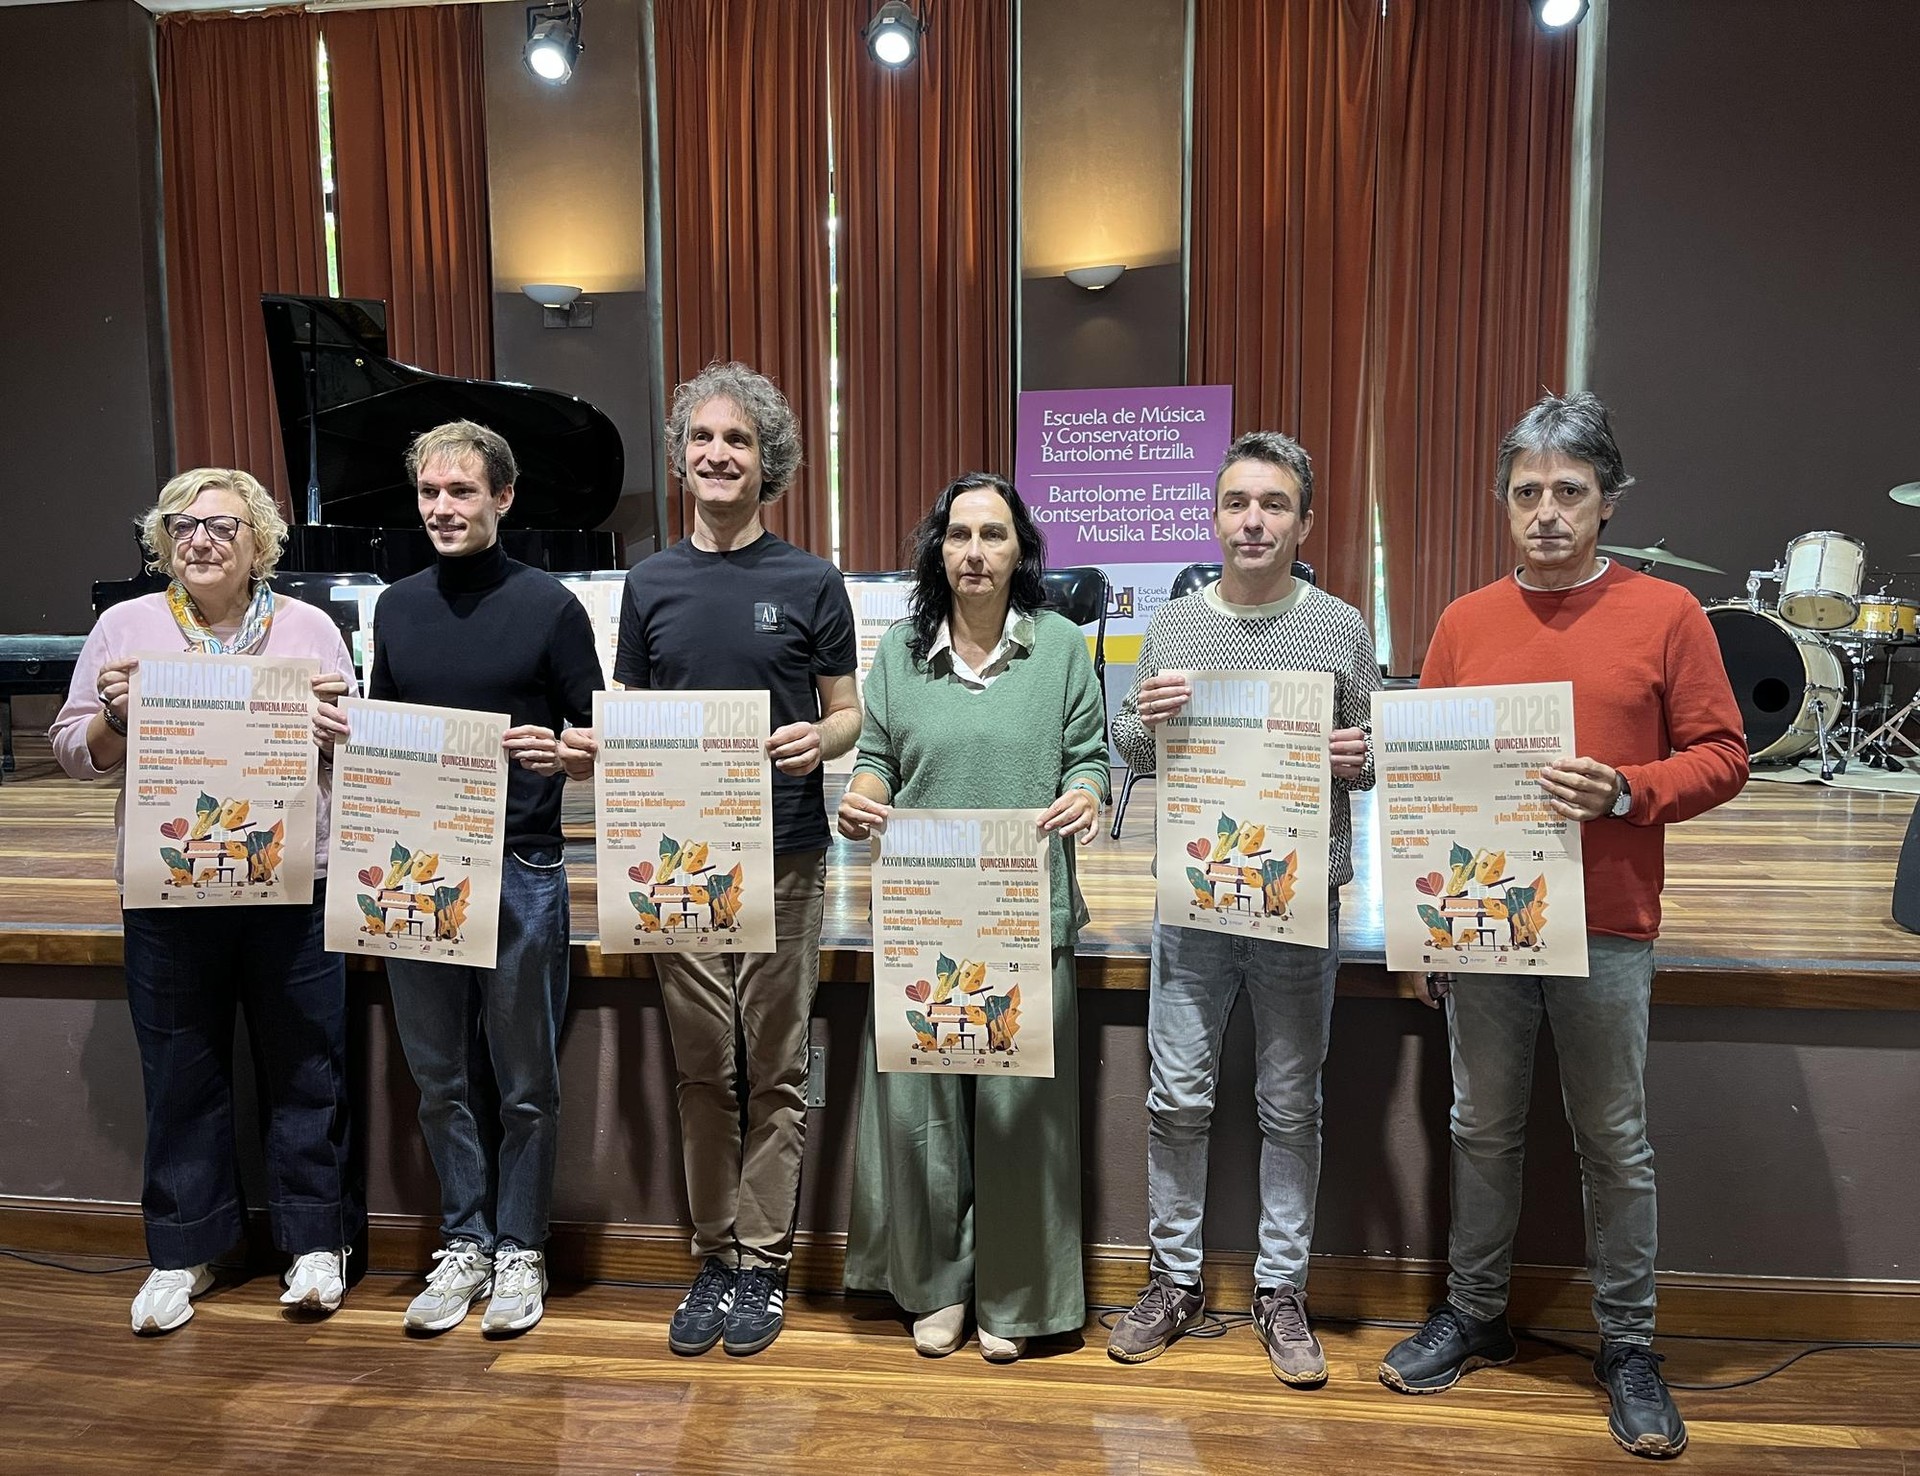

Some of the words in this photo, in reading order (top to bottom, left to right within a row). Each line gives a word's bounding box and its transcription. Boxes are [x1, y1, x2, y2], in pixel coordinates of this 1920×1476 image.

[1043, 409, 1107, 426] Escuela
[1113, 408, 1135, 425] de
[1140, 406, 1205, 423] Música
[1041, 429, 1053, 447] y
[1057, 426, 1179, 443] Conservatorio
[1042, 444, 1133, 462] Bartolomé
[1139, 443, 1194, 460] Ertzilla
[1048, 485, 1146, 503] Bartolome
[1152, 483, 1211, 501] Ertzilla
[1030, 505, 1174, 523] Kontserbatorioa
[1180, 507, 1209, 521] eta
[1077, 525, 1144, 542] Musika
[1151, 523, 1210, 541] Eskola
[251, 666, 309, 701] 2026
[141, 697, 163, 707] XXXVII
[165, 698, 190, 709] MUSIKA
[192, 699, 246, 711] HAMABOSTALDIA
[249, 701, 280, 715] QUINCENA
[281, 702, 308, 713] MUSICAL
[1268, 681, 1323, 721] 2026
[704, 701, 759, 737] 2026
[1166, 717, 1186, 726] XXXVII
[1188, 717, 1211, 727] MUSIKA
[1213, 717, 1263, 729] HAMABOSTALDIA
[1495, 694, 1561, 736] 2026
[1266, 719, 1295, 735] QUINCENA
[1296, 721, 1321, 733] MUSICAL
[443, 718, 499, 758] 2026
[605, 739, 624, 749] XXXVII
[626, 739, 648, 749] MUSIKA
[650, 739, 699, 749] HAMABOSTALDIA
[703, 739, 732, 752] QUINCENA
[733, 739, 758, 749] MUSICAL
[1385, 741, 1406, 752] XXXVII
[1408, 741, 1433, 752] MUSIKA
[1435, 739, 1490, 751] HAMABOSTALDIA
[1494, 737, 1529, 753] QUINCENA
[1530, 736, 1561, 749] MUSICAL
[345, 744, 364, 755] XXXVII
[366, 746, 388, 758] MUSIKA
[389, 749, 438, 764] HAMABOSTALDIA
[441, 754, 470, 770] QUINCENA
[471, 757, 496, 770] MUSICAL
[981, 820, 1038, 856] 2026
[882, 856, 901, 867] XXXVII
[903, 857, 925, 867] MUSIKA
[927, 857, 976, 868] HAMABOSTALDIA
[980, 858, 1010, 871] QUINCENA
[1011, 858, 1037, 868] MUSICAL
